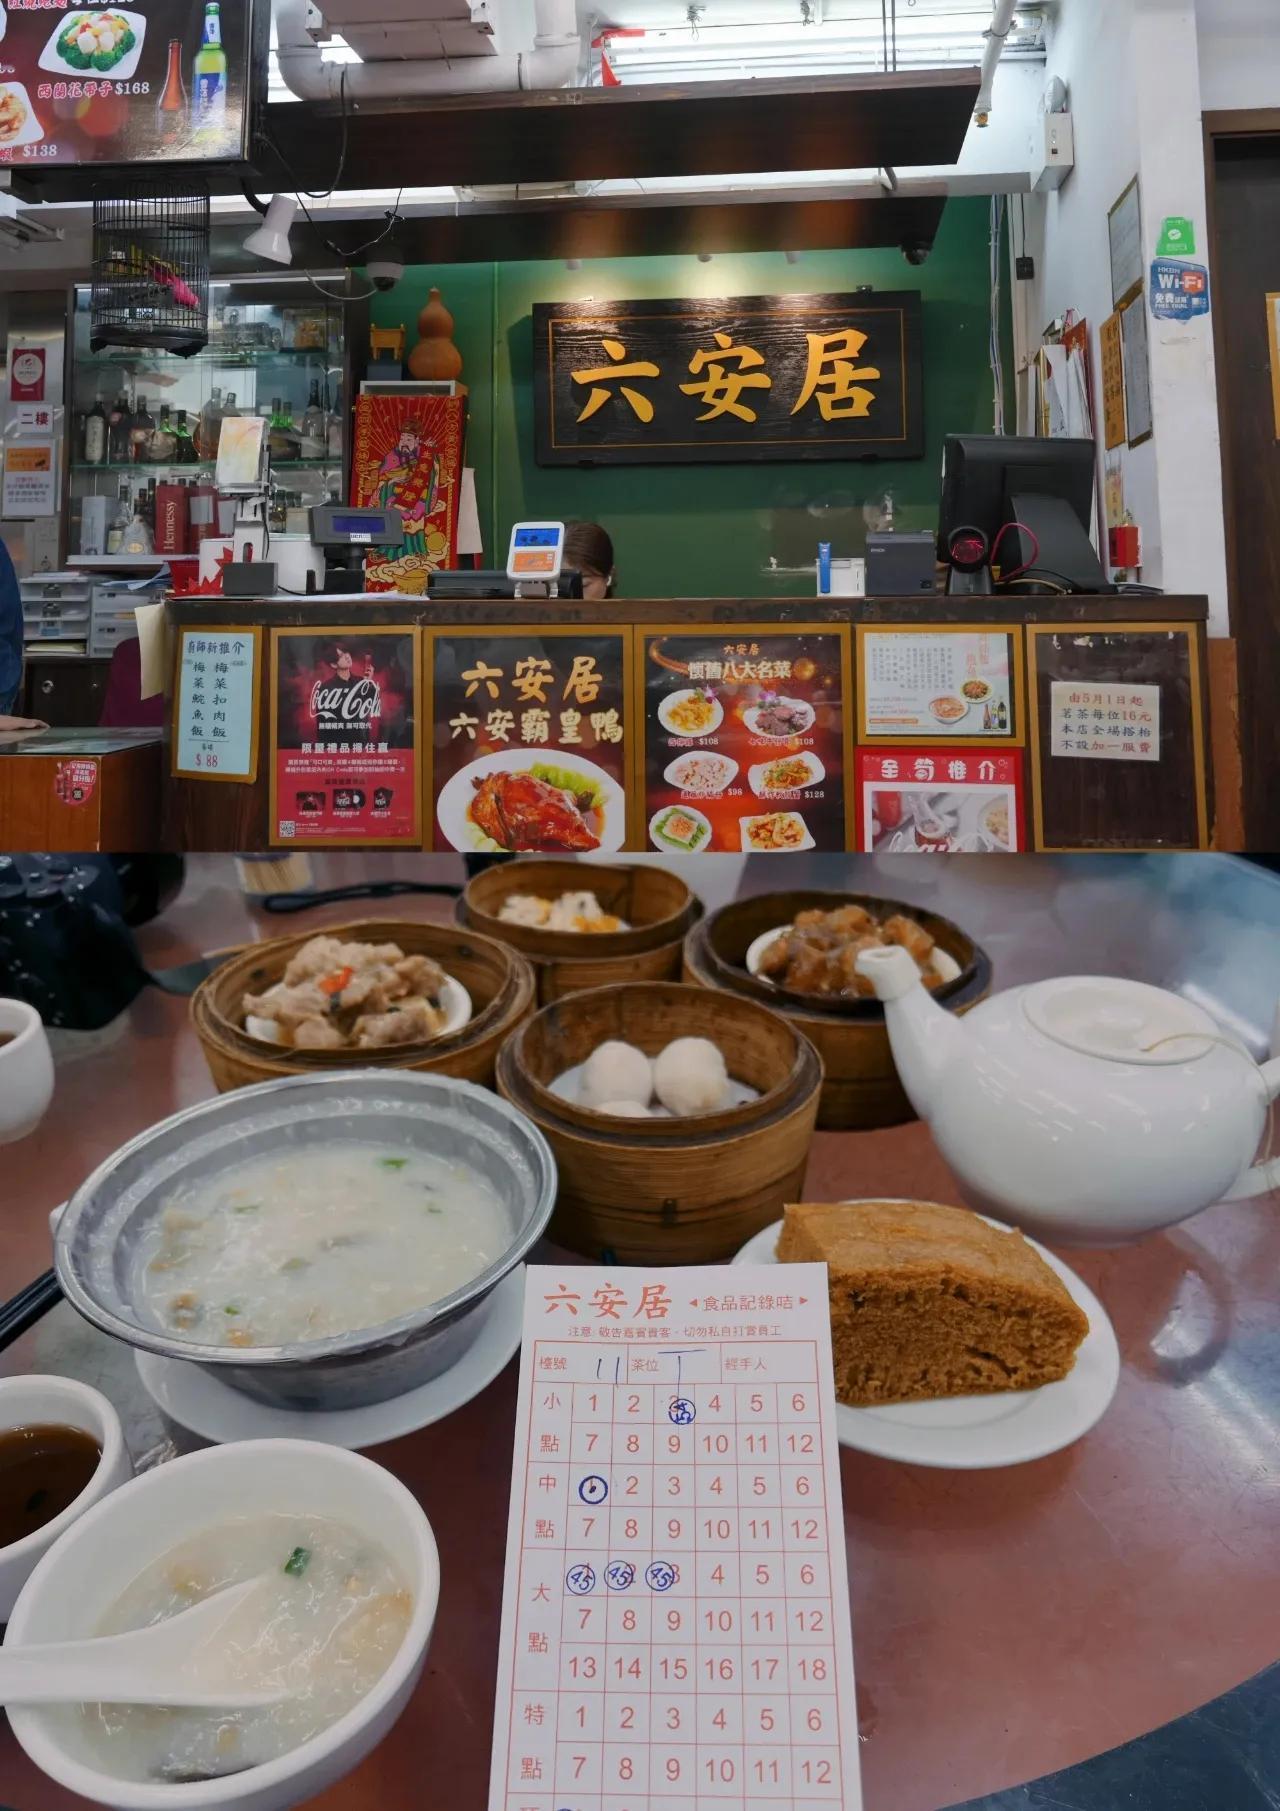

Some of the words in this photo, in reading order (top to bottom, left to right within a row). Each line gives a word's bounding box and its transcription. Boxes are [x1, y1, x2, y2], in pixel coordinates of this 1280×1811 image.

[115, 82, 150, 95] $168
[23, 145, 57, 157] $138
[1158, 273, 1202, 289] Wi-Fi
[571, 328, 881, 423] 六安居
[164, 500, 177, 551] Hennessy
[723, 643, 761, 656] 六安居
[461, 656, 603, 704] 六安居
[688, 660, 793, 680] 懷舊八大名菜
[212, 662, 230, 738] 梅菜扣肉飯
[1069, 692, 1144, 707] 由5月1日起
[449, 708, 624, 744] 六安霸皇鴨
[699, 737, 719, 746] $108
[804, 790, 825, 799] $128
[543, 1283, 672, 1320] 六安居
[568, 1326, 592, 1338] 注意
[631, 1359, 660, 1372] 茶位
[726, 1358, 768, 1371] 經手人
[589, 1395, 596, 1411] 1
[628, 1395, 640, 1412] 2
[709, 1395, 721, 1412] 4
[751, 1395, 762, 1412] 5
[792, 1394, 805, 1411] 6
[586, 1434, 598, 1451] 7
[627, 1435, 639, 1452] 8
[669, 1435, 680, 1453] 9
[703, 1435, 728, 1453] 10
[746, 1434, 766, 1453] 11
[787, 1435, 813, 1453] 12
[626, 1476, 638, 1494] 2
[668, 1476, 680, 1495] 3
[710, 1477, 722, 1494] 4
[754, 1477, 766, 1495] 5
[796, 1476, 809, 1495] 6
[583, 1518, 595, 1537] 7
[625, 1519, 637, 1538] 8
[668, 1519, 680, 1538] 9
[704, 1520, 730, 1539] 10
[749, 1520, 769, 1538] 11
[792, 1520, 818, 1539] 12
[711, 1565, 724, 1584] 4
[756, 1565, 769, 1584] 5
[801, 1564, 814, 1584] 6
[579, 1609, 591, 1629] 7
[623, 1610, 635, 1630] 8
[667, 1610, 680, 1631] 9
[705, 1611, 732, 1631] 10
[751, 1611, 773, 1632] 11
[796, 1611, 823, 1631] 12
[569, 1657, 596, 1678] 13
[615, 1658, 641, 1679] 14
[660, 1658, 687, 1679] 15
[706, 1659, 733, 1680] 16
[752, 1659, 778, 1680] 17
[798, 1659, 826, 1680] 18
[576, 1706, 584, 1727] 1
[620, 1707, 634, 1728] 2
[667, 1707, 680, 1729] 3
[712, 1708, 726, 1729] 4
[761, 1709, 774, 1731] 5
[807, 1709, 821, 1731] 6
[573, 1757, 586, 1778] 7
[619, 1757, 632, 1780] 8
[666, 1758, 680, 1781] 9
[706, 1759, 734, 1782] 10
[755, 1760, 777, 1783] 11
[802, 1760, 831, 1784] 12
